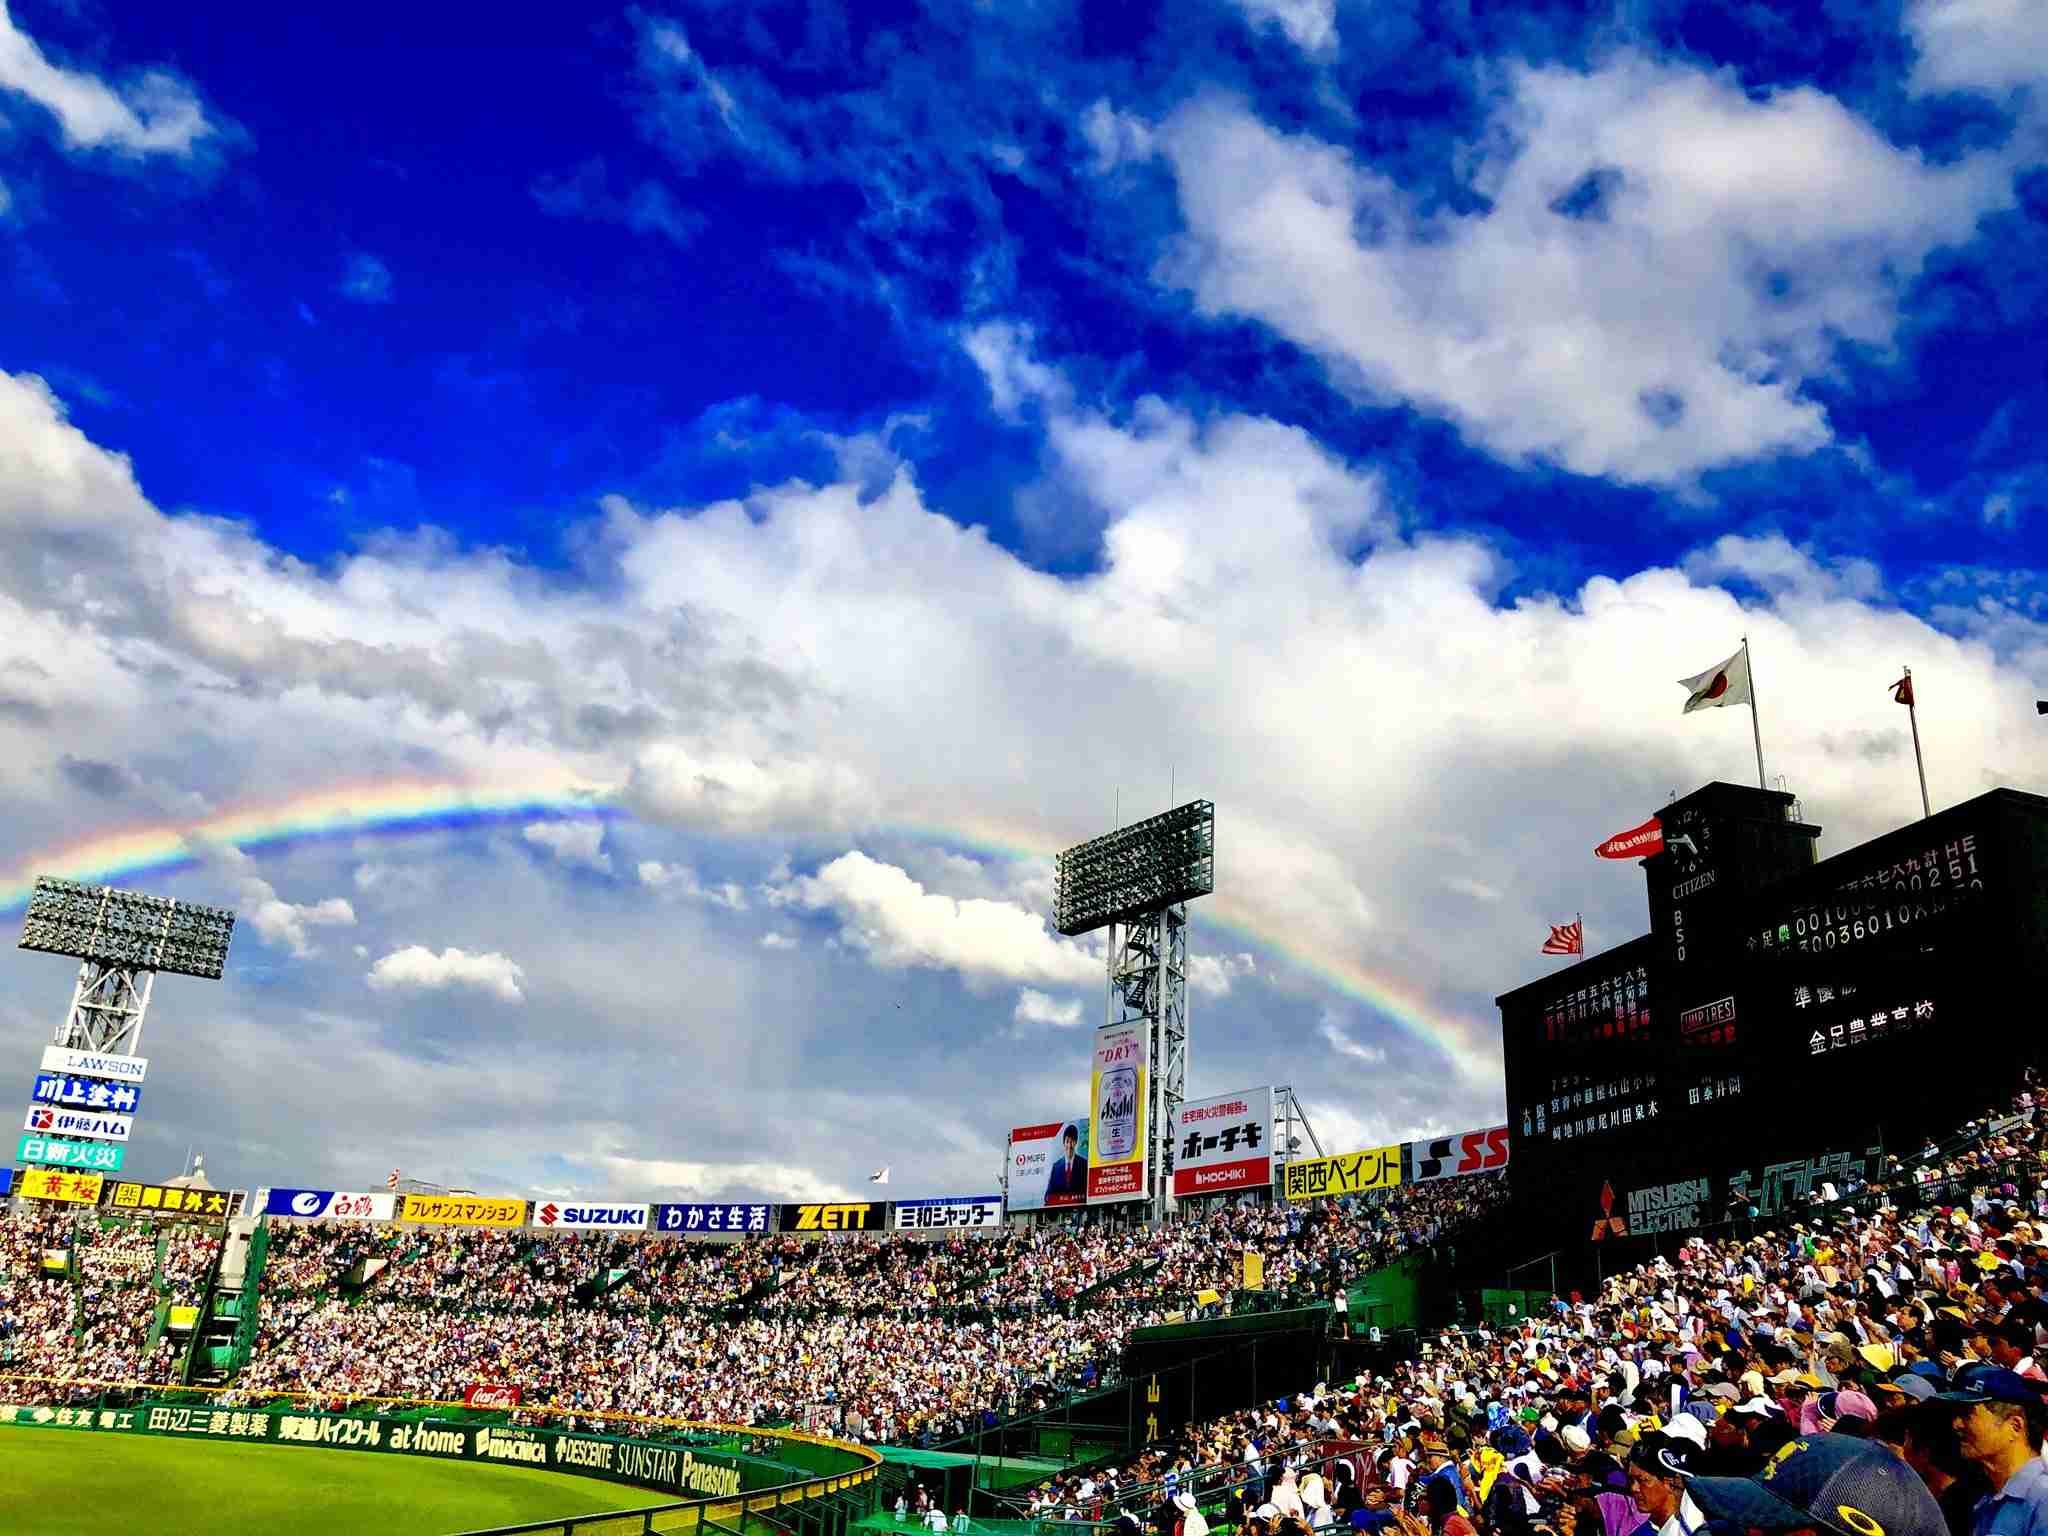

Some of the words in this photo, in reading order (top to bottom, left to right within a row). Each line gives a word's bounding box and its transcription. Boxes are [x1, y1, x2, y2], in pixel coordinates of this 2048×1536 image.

[1672, 869, 1717, 900] CITIZEN
[66, 1055, 143, 1076] LAWSON
[1101, 1094, 1133, 1120] Asahi
[57, 1115, 125, 1135] 伊藤ハム
[23, 1139, 116, 1167] 日新火災
[1181, 1122, 1262, 1159] ホーチキ
[43, 1174, 98, 1199] 黄桜
[1203, 1168, 1246, 1183] HOCHIKI
[1288, 1151, 1399, 1195] 関西ペイント
[1627, 1177, 1711, 1213] MITSUBISHI
[563, 1208, 644, 1224] SUZUKI
[666, 1206, 767, 1231] わかさ生活
[796, 1204, 871, 1230] ZETT
[901, 1205, 994, 1227] 三和シャッター
[1629, 1206, 1699, 1236] ELECTRIC
[149, 1407, 269, 1437] 田辺三菱製薬
[278, 1416, 381, 1446] 東進ハイスクール
[566, 1440, 612, 1470] DESCENTE
[617, 1444, 676, 1483] SUNSTAR
[682, 1451, 741, 1495] Panasonic
